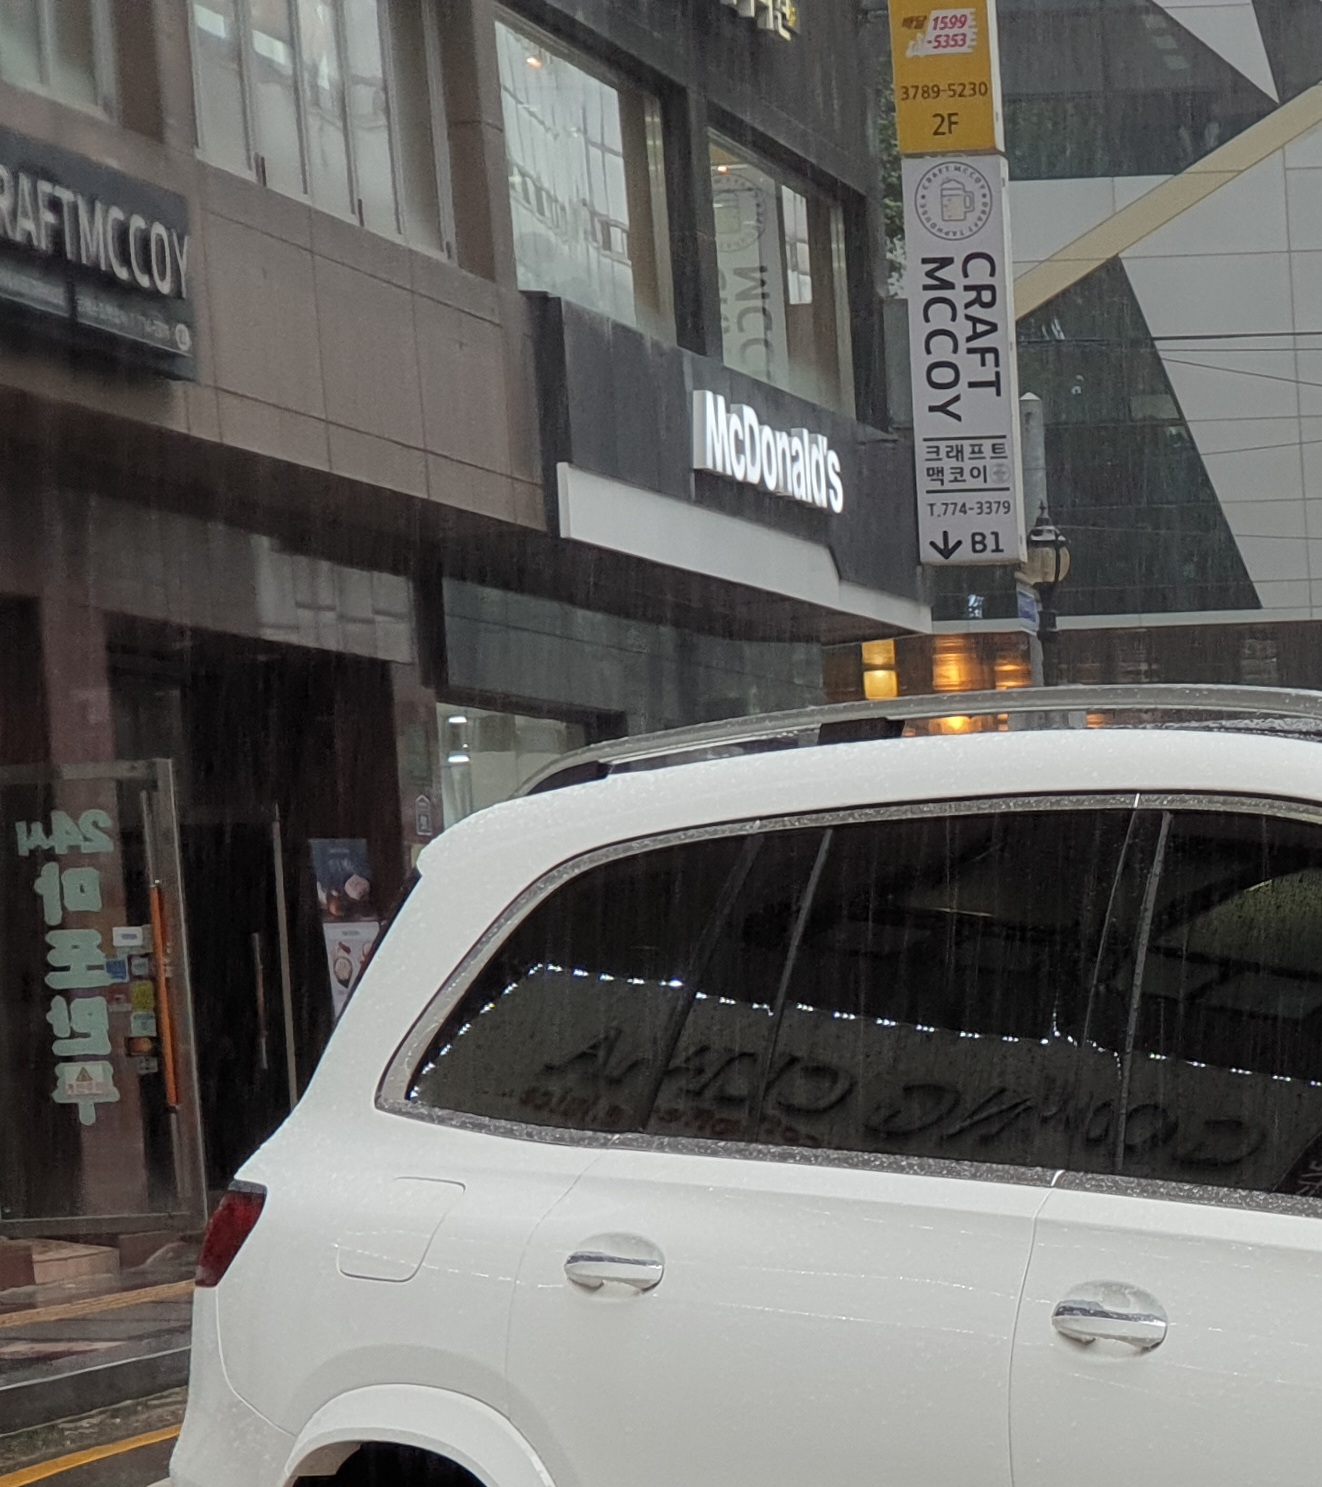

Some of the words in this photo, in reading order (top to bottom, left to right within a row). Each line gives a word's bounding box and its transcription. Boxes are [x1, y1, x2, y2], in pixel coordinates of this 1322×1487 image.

[932, 14, 968, 30] 1599
[901, 81, 988, 101] 3789-5230
[933, 113, 959, 136] 2F
[961, 251, 1002, 397] CRAFT
[921, 256, 963, 422] MCCOY
[704, 389, 845, 514] McDonald's
[924, 442, 1008, 462] 크래프트
[926, 464, 987, 486] 맥코이
[970, 531, 1005, 554] B1
